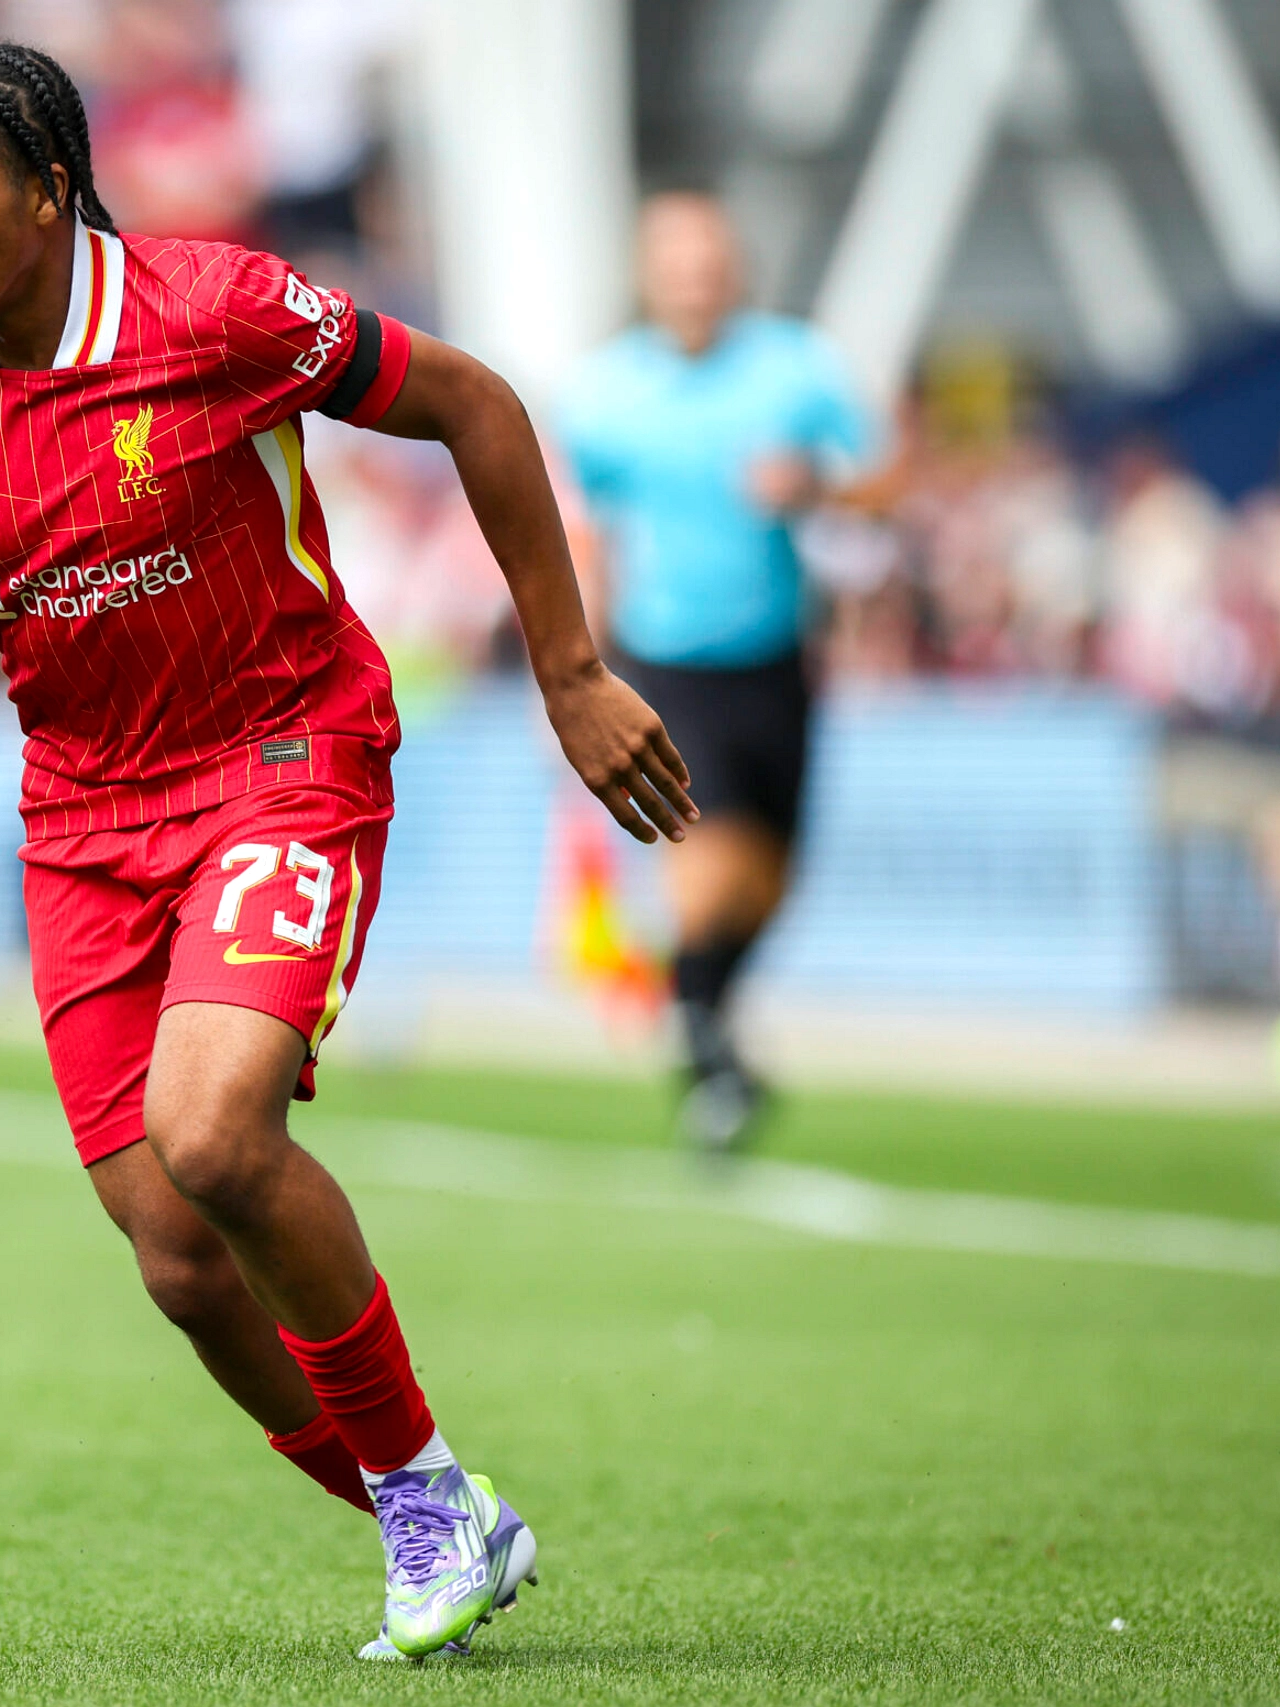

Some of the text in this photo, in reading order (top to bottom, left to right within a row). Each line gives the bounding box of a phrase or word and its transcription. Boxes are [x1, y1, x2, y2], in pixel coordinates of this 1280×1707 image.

[117, 478, 167, 503] L.F.C.
[21, 552, 193, 618] chartered
[213, 841, 334, 952] 73
[431, 1564, 487, 1630] F50
